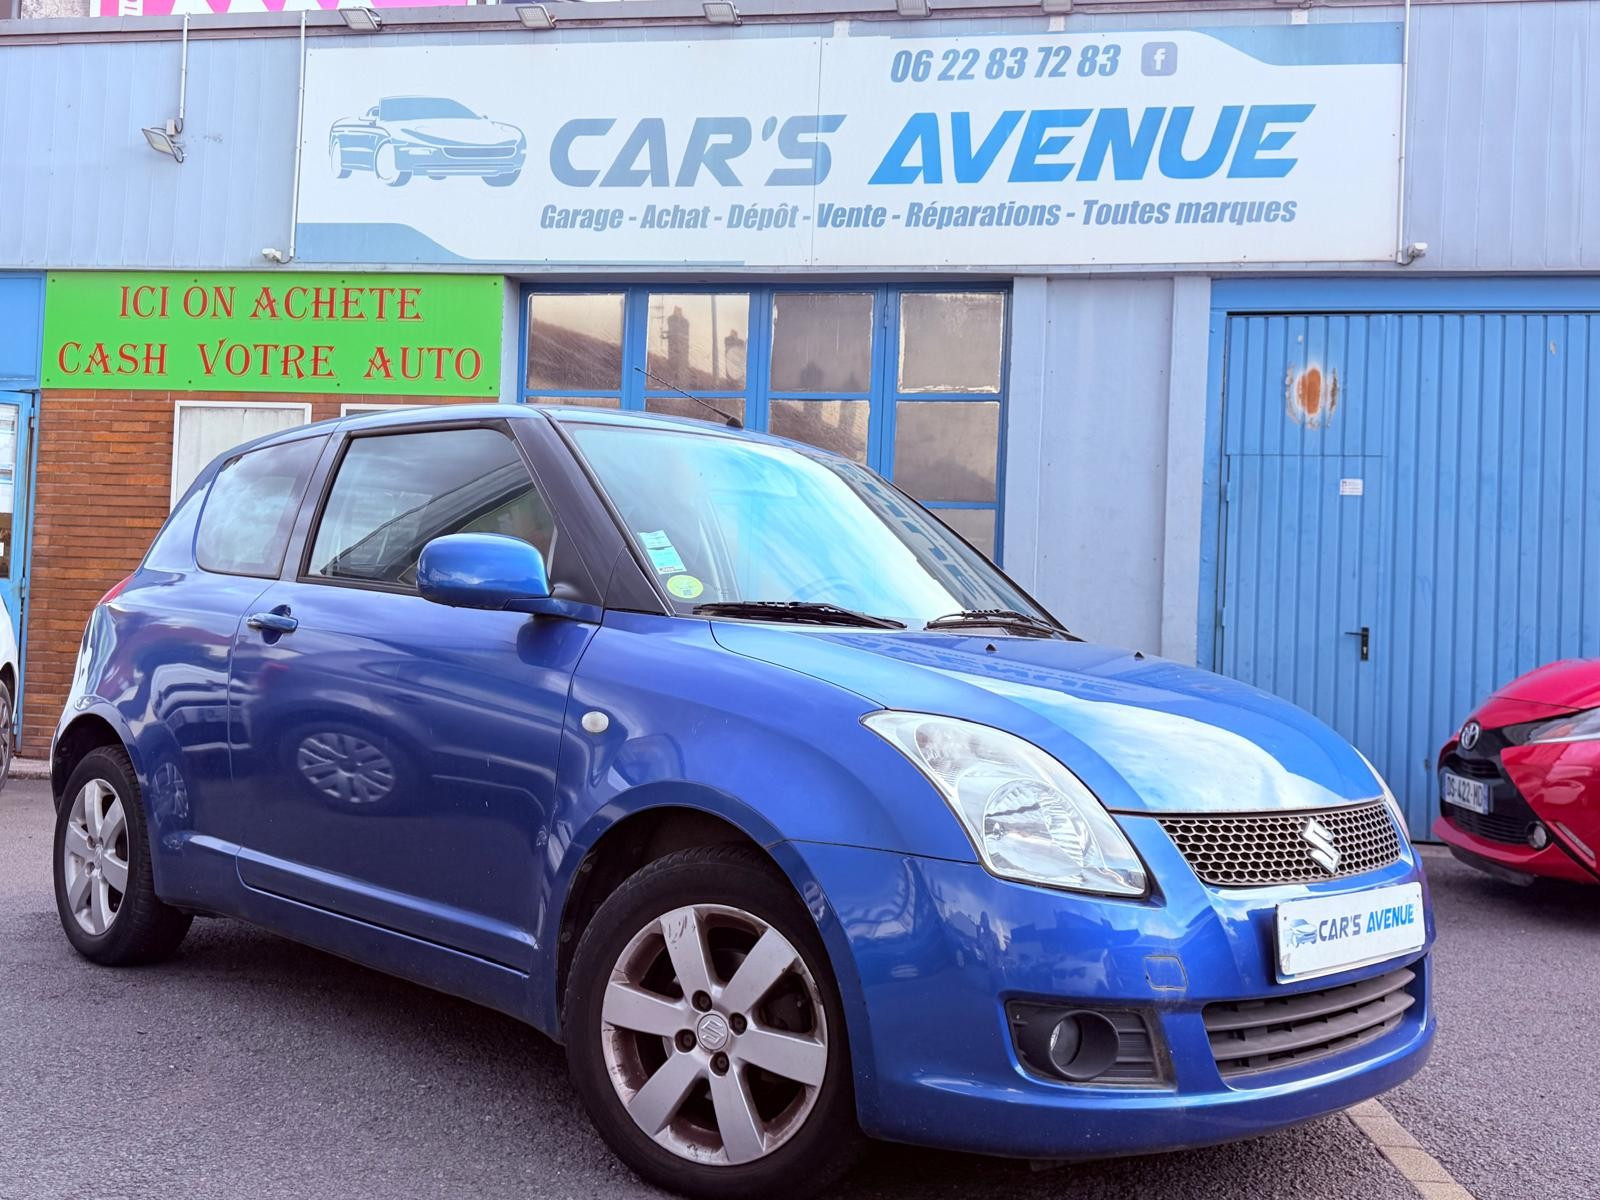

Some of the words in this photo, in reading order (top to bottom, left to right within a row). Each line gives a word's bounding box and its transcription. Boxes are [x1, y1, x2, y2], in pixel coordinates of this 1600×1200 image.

[890, 49, 933, 83] 06
[937, 48, 980, 81] 22
[985, 47, 1028, 80] 83
[1034, 45, 1072, 78] 72
[1076, 44, 1121, 77] 83
[550, 114, 848, 187] CAR'S
[867, 104, 1317, 185] AVENUE
[540, 204, 624, 231] Garage
[640, 204, 711, 229] Achat
[726, 203, 800, 231] Dépôt
[817, 203, 887, 228] Vente
[905, 201, 1061, 230] Réparations
[1083, 199, 1171, 225] Toutes
[1175, 200, 1297, 226] marques
[119, 286, 169, 319] ICI
[183, 286, 236, 319] ON
[249, 286, 424, 321] ACHETE
[58, 341, 168, 376] CASH
[197, 337, 336, 380] VOTRE
[363, 346, 482, 381] AUTO
[1319, 914, 1362, 941] CAR'S
[1366, 903, 1414, 933] AVENUE
